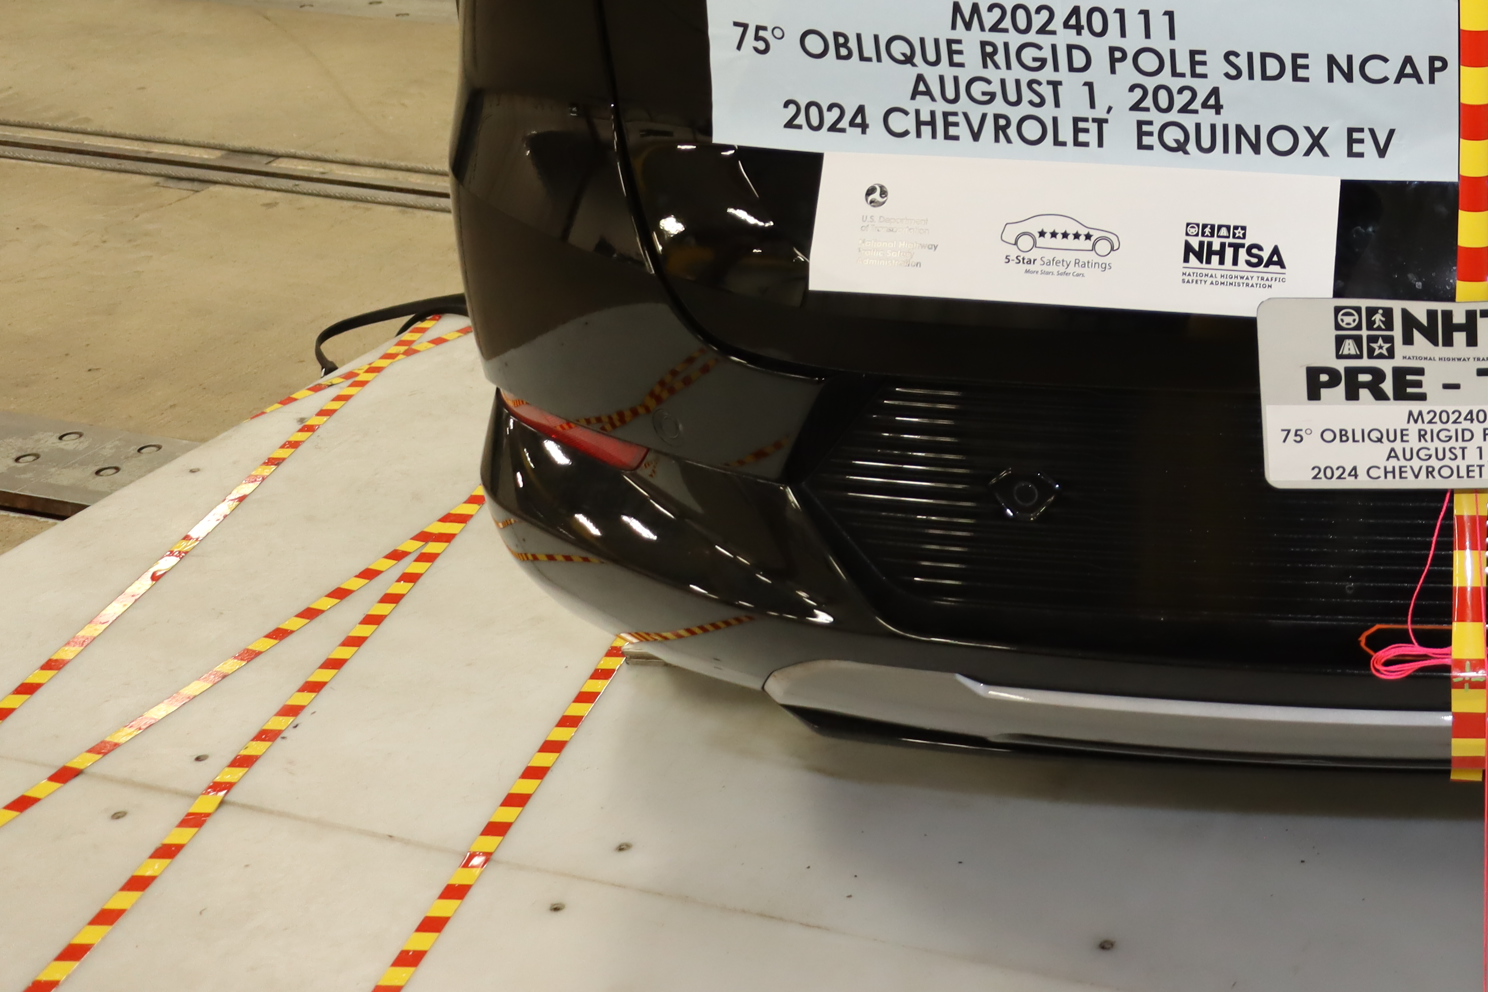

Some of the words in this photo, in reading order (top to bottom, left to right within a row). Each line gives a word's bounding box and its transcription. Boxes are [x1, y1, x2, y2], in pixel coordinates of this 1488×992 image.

[951, 1, 1175, 40] M20240111
[800, 29, 965, 67] OBLIQUE
[980, 41, 1091, 72] RIGID
[1109, 46, 1208, 78] POLE
[1224, 51, 1309, 82] SIDE
[1327, 54, 1448, 84] NCAP
[910, 74, 1062, 108] AUGUST
[1082, 82, 1112, 114] 1,
[1128, 83, 1223, 115] 2024
[783, 99, 869, 134] 2024
[883, 106, 1108, 148] CHEVROLET
[1137, 120, 1329, 157] EQUINOX
[1347, 127, 1395, 158] EV
[1004, 255, 1037, 265] 5-Star
[1040, 256, 1071, 269] Safety
[1074, 259, 1112, 272] Ratings
[1183, 239, 1286, 269] NHTSA
[1210, 280, 1272, 288] ADMINISTRATION
[1306, 367, 1427, 401] PRE
[1320, 428, 1409, 443] OBLIQUE
[1418, 428, 1474, 442] RIGID
[1386, 447, 1467, 461] AUGUST
[1312, 466, 1358, 480] 2024
[1367, 465, 1484, 479] CHEVROLET
